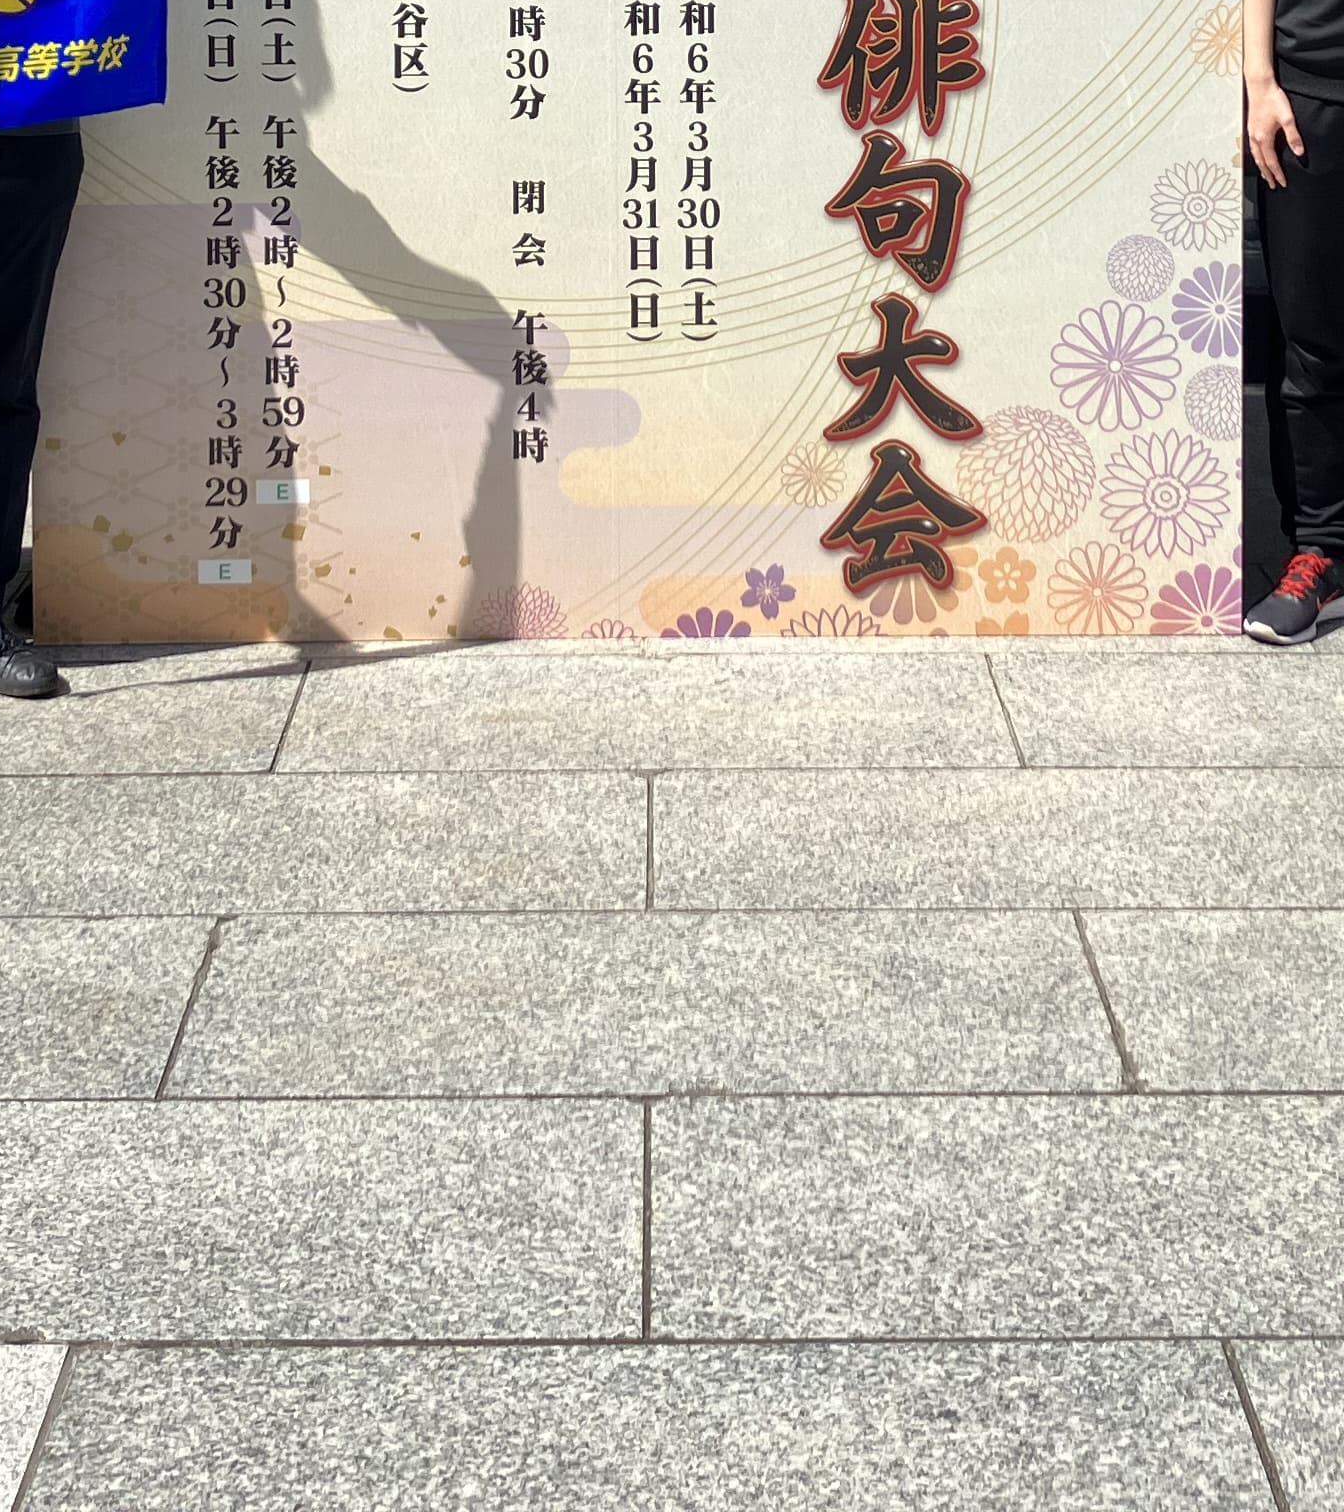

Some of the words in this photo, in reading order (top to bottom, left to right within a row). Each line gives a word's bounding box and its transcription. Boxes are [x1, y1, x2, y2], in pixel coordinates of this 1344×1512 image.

[512, 181, 545, 266] 閉会
[512, 310, 548, 463] 午後4時
[276, 483, 289, 501] E
[218, 563, 232, 580] E
